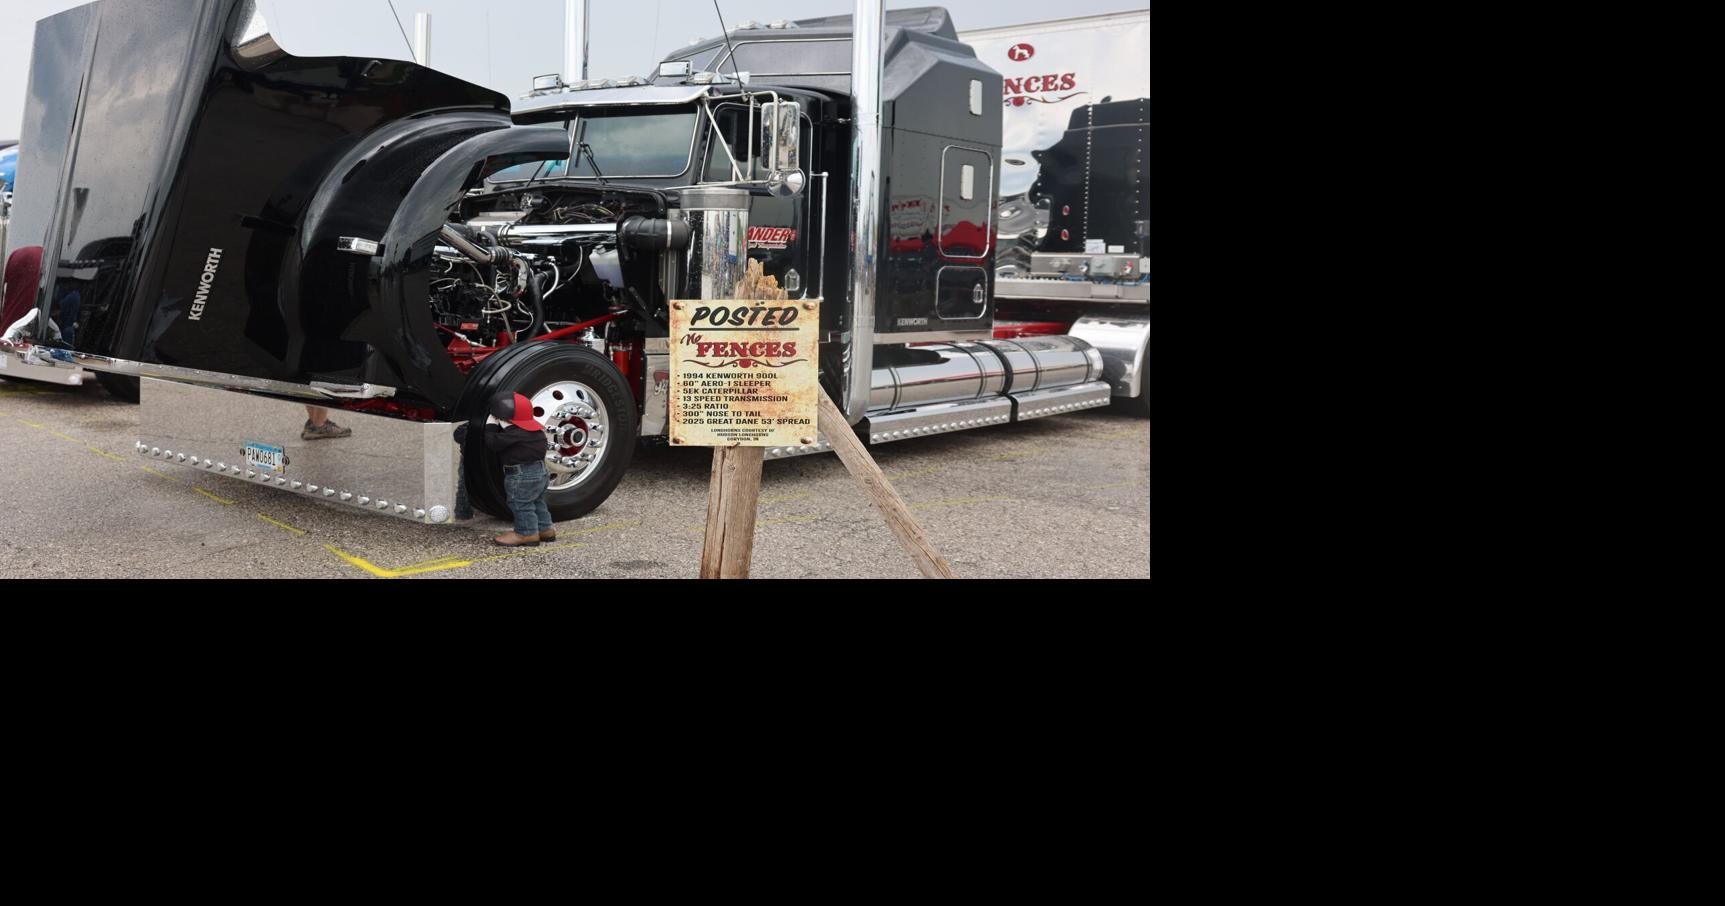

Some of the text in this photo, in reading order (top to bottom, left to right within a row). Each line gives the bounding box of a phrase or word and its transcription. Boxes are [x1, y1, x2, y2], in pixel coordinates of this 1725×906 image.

[1003, 73, 1076, 95] NCES
[188, 247, 223, 321] KENWORTH
[690, 306, 799, 326] POSTED
[680, 332, 703, 346] No
[696, 341, 797, 358] FENCES
